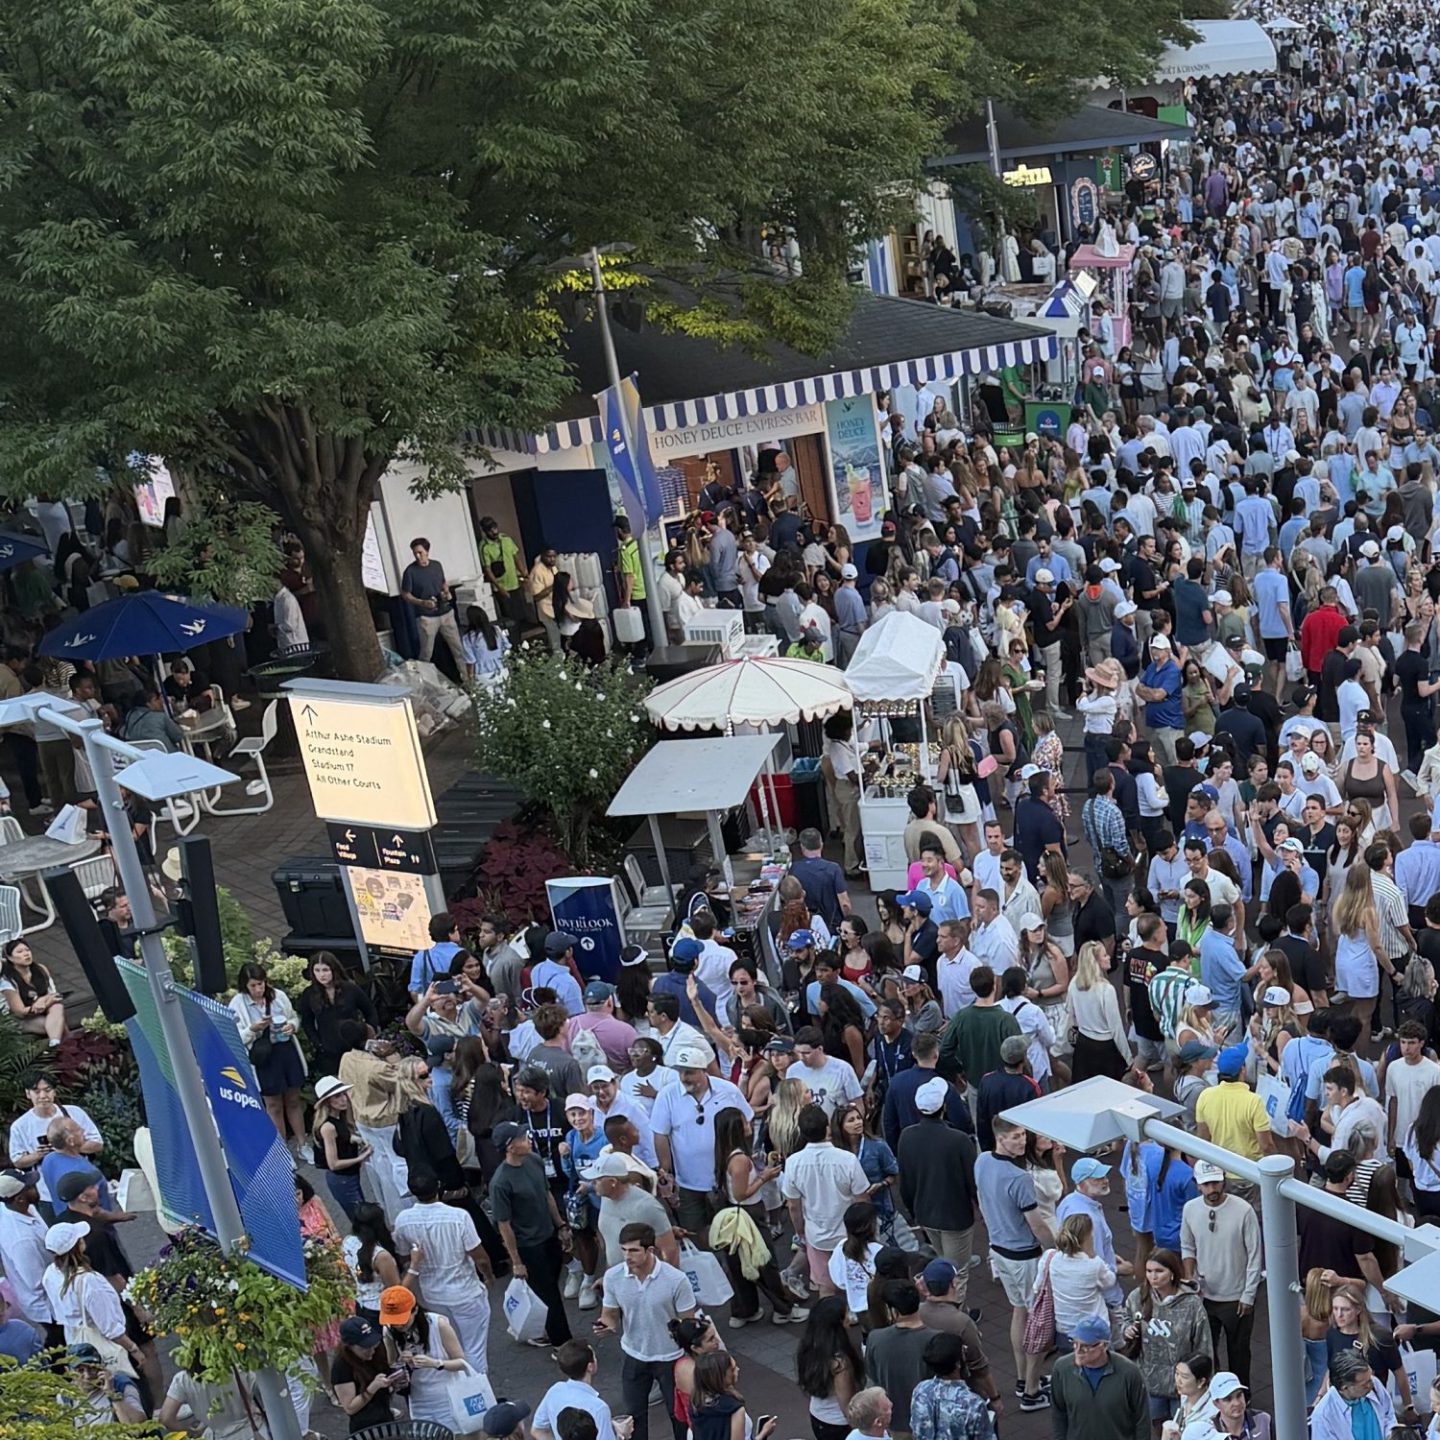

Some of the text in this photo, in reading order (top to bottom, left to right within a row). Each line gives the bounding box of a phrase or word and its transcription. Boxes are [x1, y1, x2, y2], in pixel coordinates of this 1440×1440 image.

[654, 410, 818, 450] HONEY DEUCE EXPRESS BAR
[836, 418, 864, 429] HONEY
[838, 428, 866, 439] DEUCE
[305, 729, 392, 746] Arthur Ashe Stadium
[308, 744, 355, 758] Grandstand
[312, 759, 345, 772] Stadium
[327, 775, 351, 787] Other
[353, 778, 381, 790] Courts
[557, 918, 614, 928] OVERLOOK
[219, 1085, 234, 1101] us
